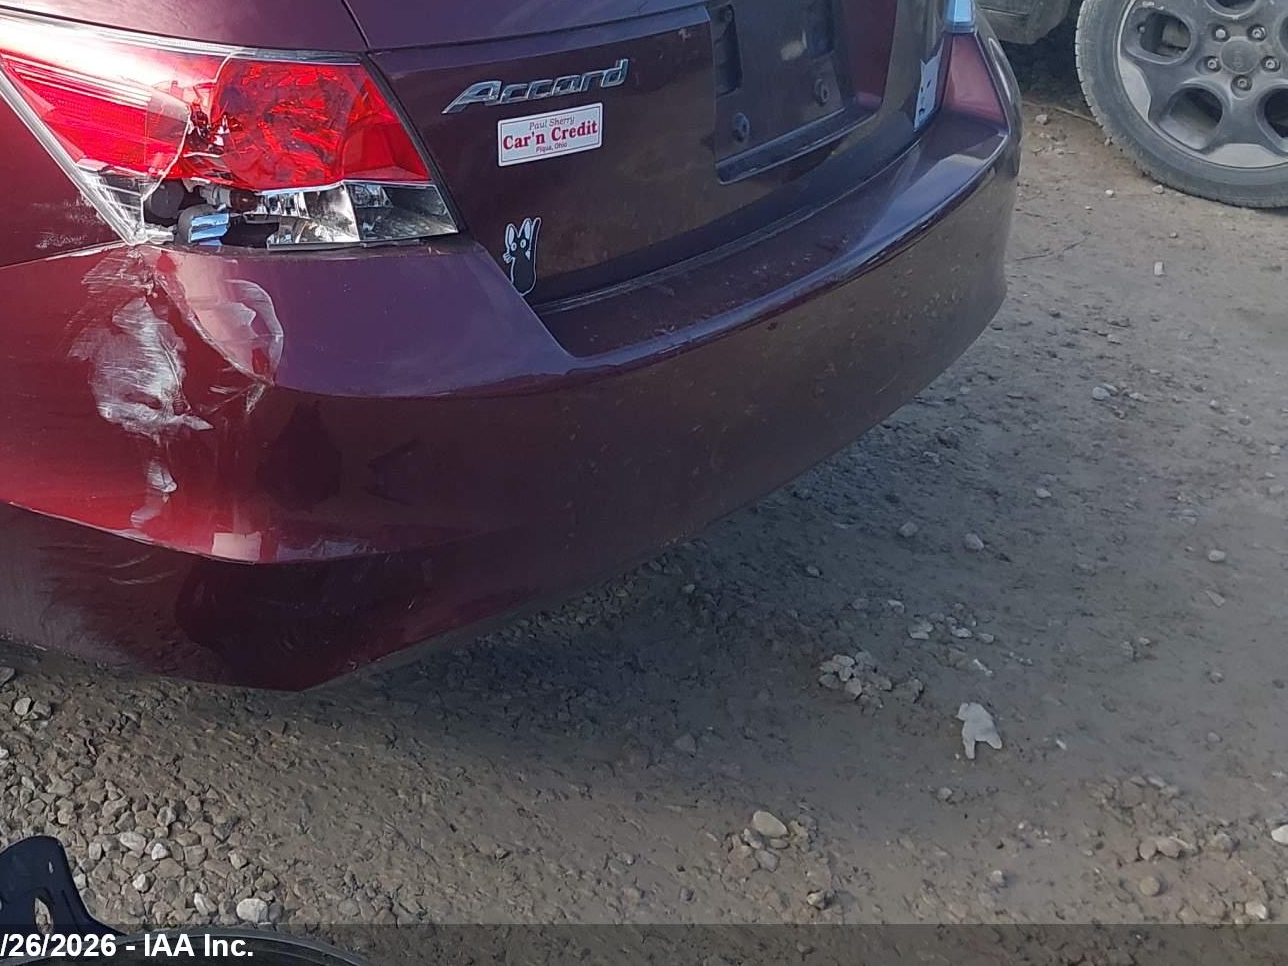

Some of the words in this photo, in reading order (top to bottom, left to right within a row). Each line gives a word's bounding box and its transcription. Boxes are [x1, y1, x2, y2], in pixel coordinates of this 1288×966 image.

[441, 58, 629, 114] Accord
[502, 131, 546, 151] Car'n
[551, 120, 598, 142] Credit
[529, 117, 548, 131] Paul
[548, 115, 576, 127] Sherry
